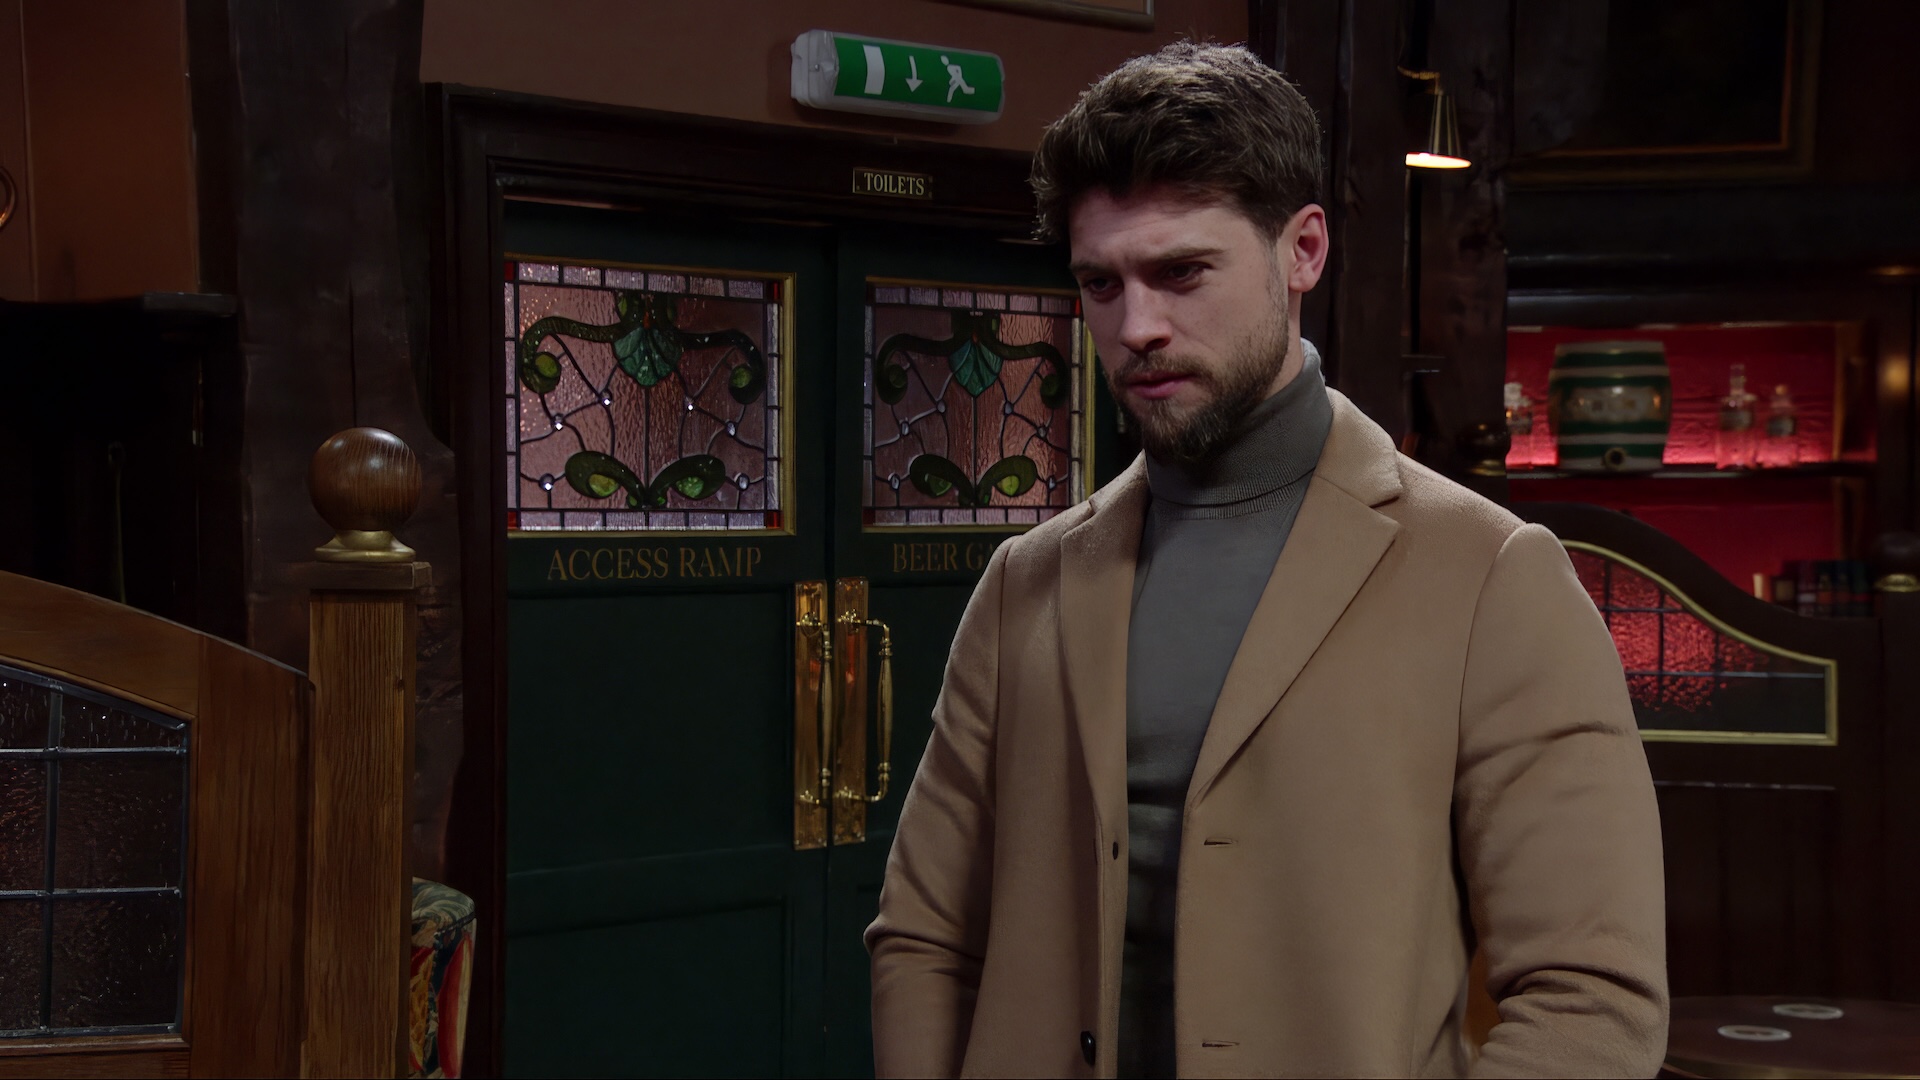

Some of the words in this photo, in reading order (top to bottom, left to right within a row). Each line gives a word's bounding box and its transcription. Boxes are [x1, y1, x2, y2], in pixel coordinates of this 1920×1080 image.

[863, 172, 925, 196] TOILETS
[547, 547, 669, 581] ACCESS
[679, 546, 762, 578] RAMP
[892, 542, 958, 573] BEER
[965, 542, 994, 572] G
